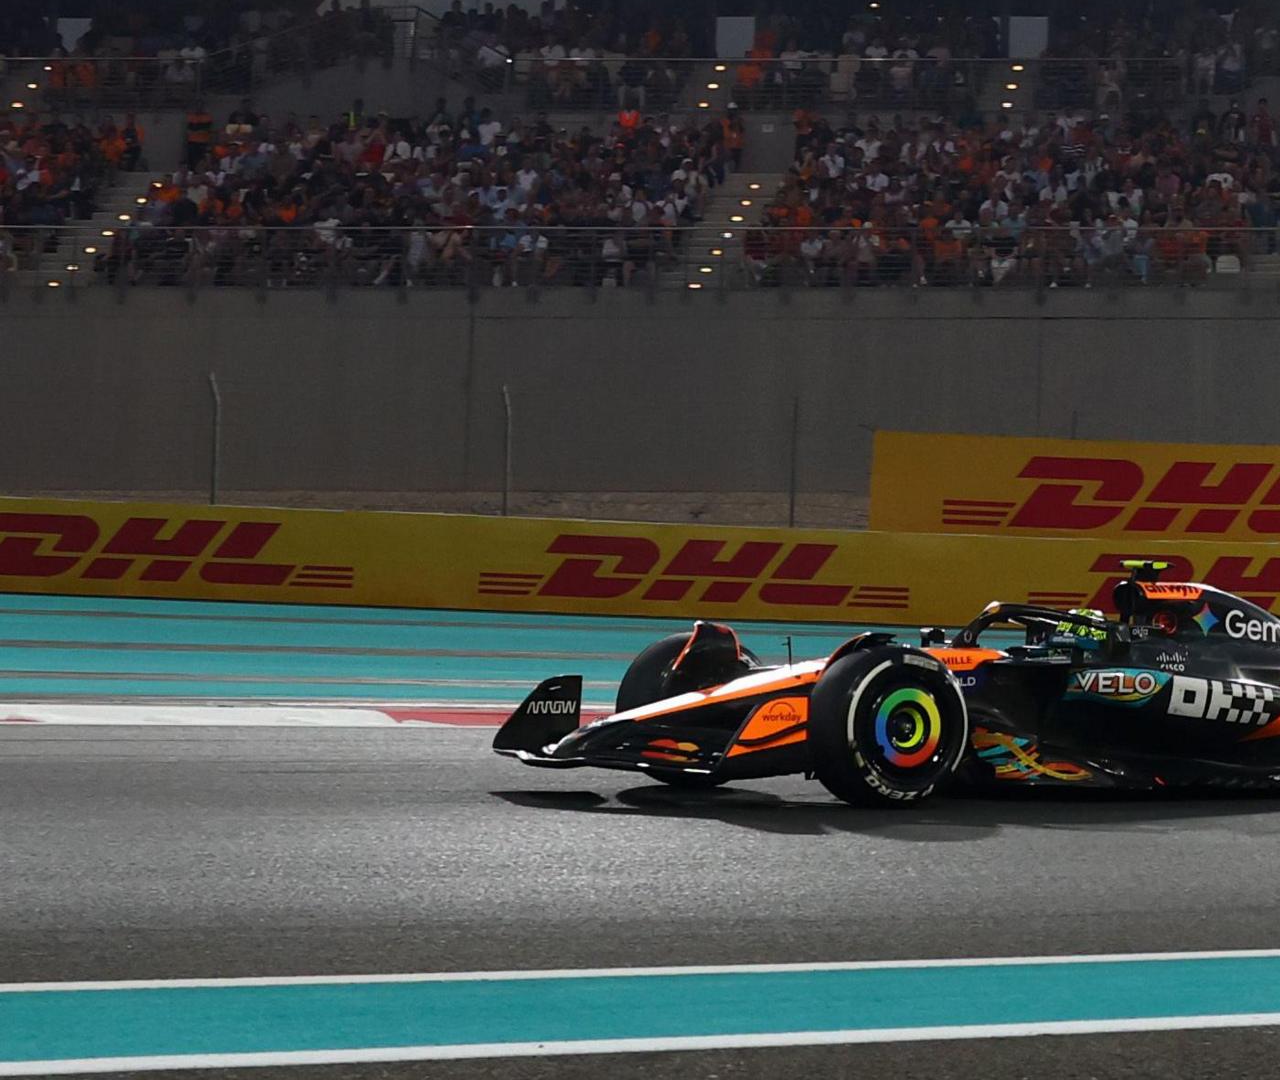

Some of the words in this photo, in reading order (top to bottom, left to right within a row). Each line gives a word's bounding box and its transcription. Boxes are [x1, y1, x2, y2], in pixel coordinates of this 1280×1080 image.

[0, 512, 296, 586] DHL
[536, 534, 854, 607] DHL
[1076, 672, 1155, 694] VELO
[762, 712, 802, 723] workday
